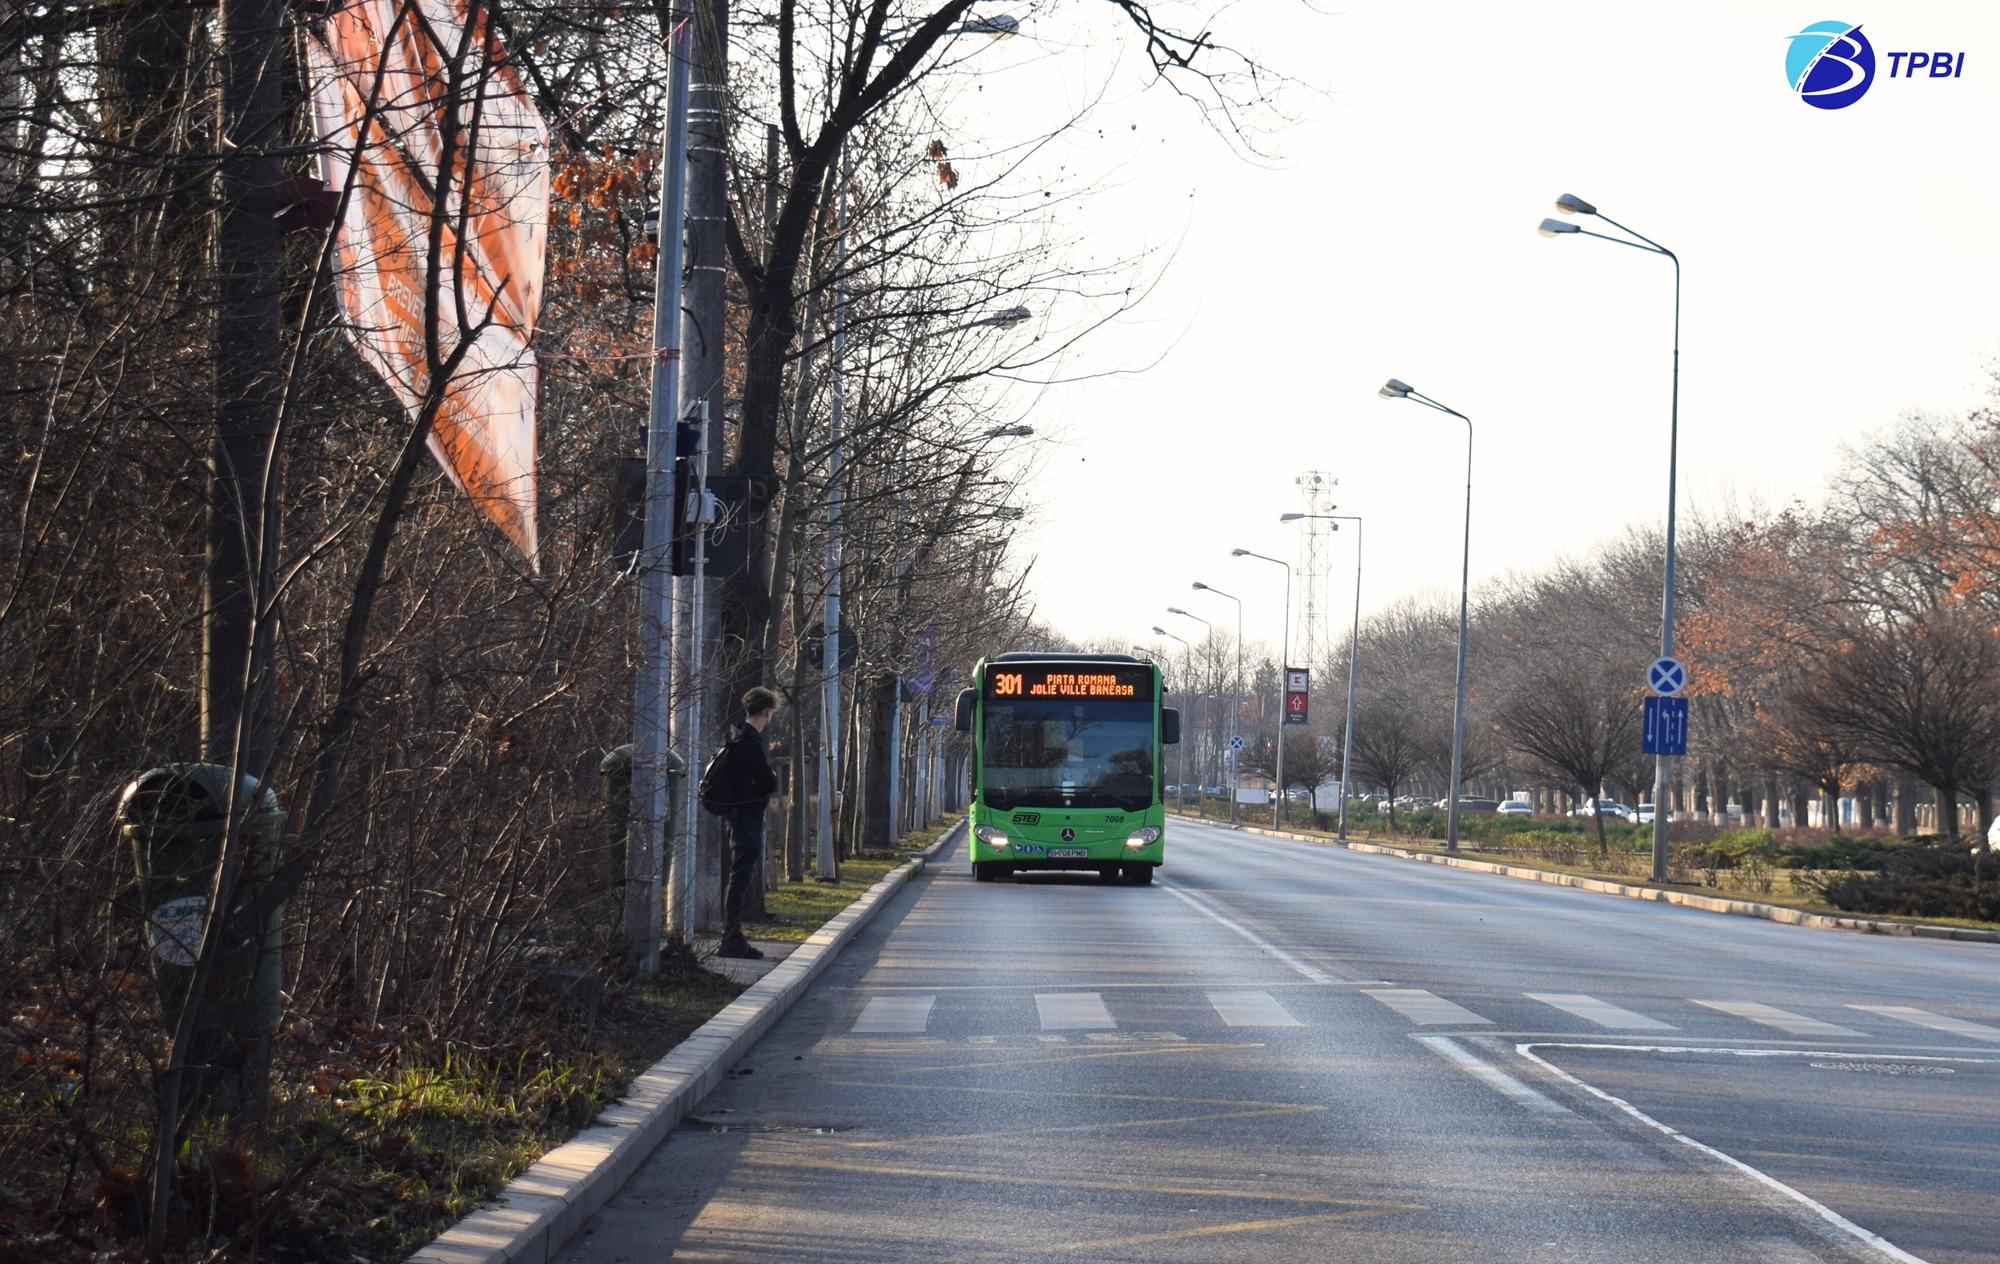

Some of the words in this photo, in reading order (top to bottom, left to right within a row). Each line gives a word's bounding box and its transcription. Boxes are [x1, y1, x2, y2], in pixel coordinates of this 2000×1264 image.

[995, 673, 1023, 695] 301
[1046, 674, 1075, 685] PIATA
[1078, 674, 1116, 685] ROMANA
[1030, 684, 1057, 695] JOLIE
[1060, 684, 1087, 695] VILLE
[1090, 684, 1134, 695] BANEASA
[1012, 813, 1038, 823] STB
[1105, 815, 1125, 823] 7008
